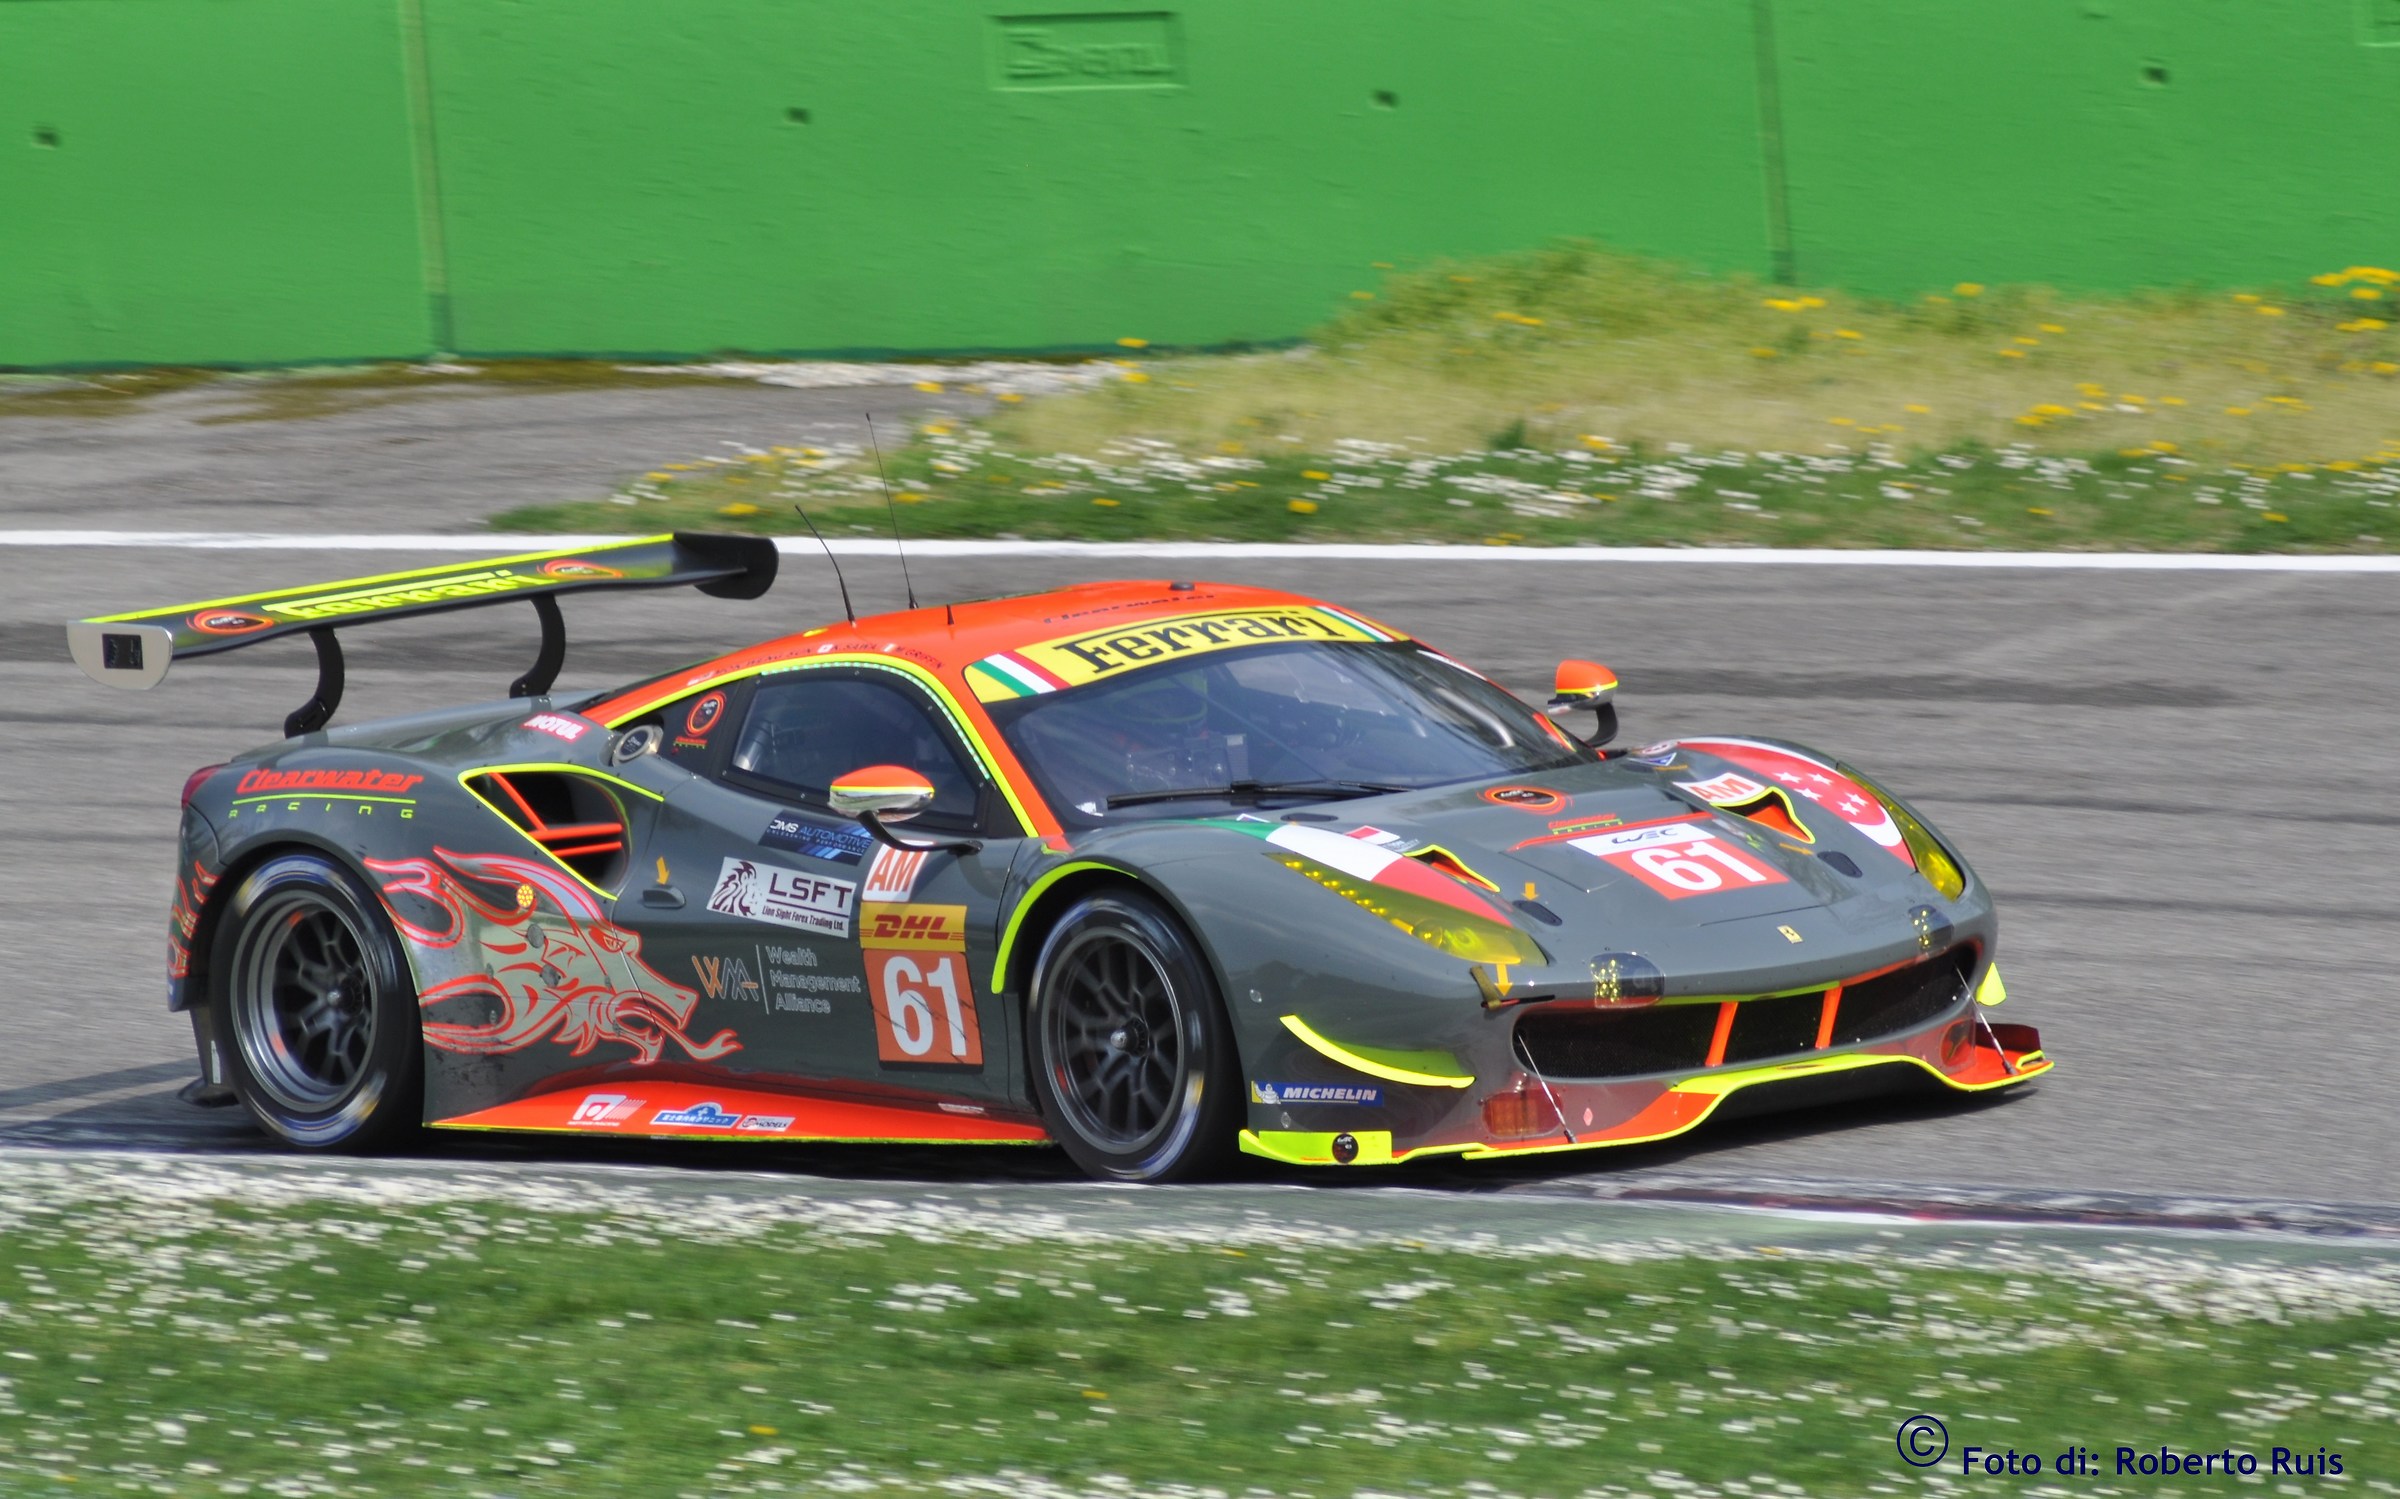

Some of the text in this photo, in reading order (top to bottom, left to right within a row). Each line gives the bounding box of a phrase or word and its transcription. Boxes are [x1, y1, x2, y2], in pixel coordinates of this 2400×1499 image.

[262, 569, 558, 619] Ferrari
[1052, 610, 1345, 674] Ferrari
[526, 714, 584, 739] MOTUL
[236, 768, 424, 794] Clearwater
[1688, 778, 1754, 801] AM
[228, 801, 414, 819] RACING
[799, 825, 872, 849] AUTOMOTIVE
[1611, 826, 1680, 846] WEC
[866, 849, 927, 892] AM
[1631, 840, 1768, 892] 61
[769, 872, 853, 909] LSFT
[761, 905, 776, 917] Lion
[792, 910, 809, 924] Forex
[809, 913, 833, 929] Trading
[833, 918, 845, 931] Ltd.
[873, 914, 950, 940] DHL
[765, 945, 818, 967] Wealth
[769, 970, 861, 993] Management
[775, 992, 831, 1014] Alliance
[883, 955, 967, 1056] 61
[1283, 1086, 1378, 1101] MICHELIN
